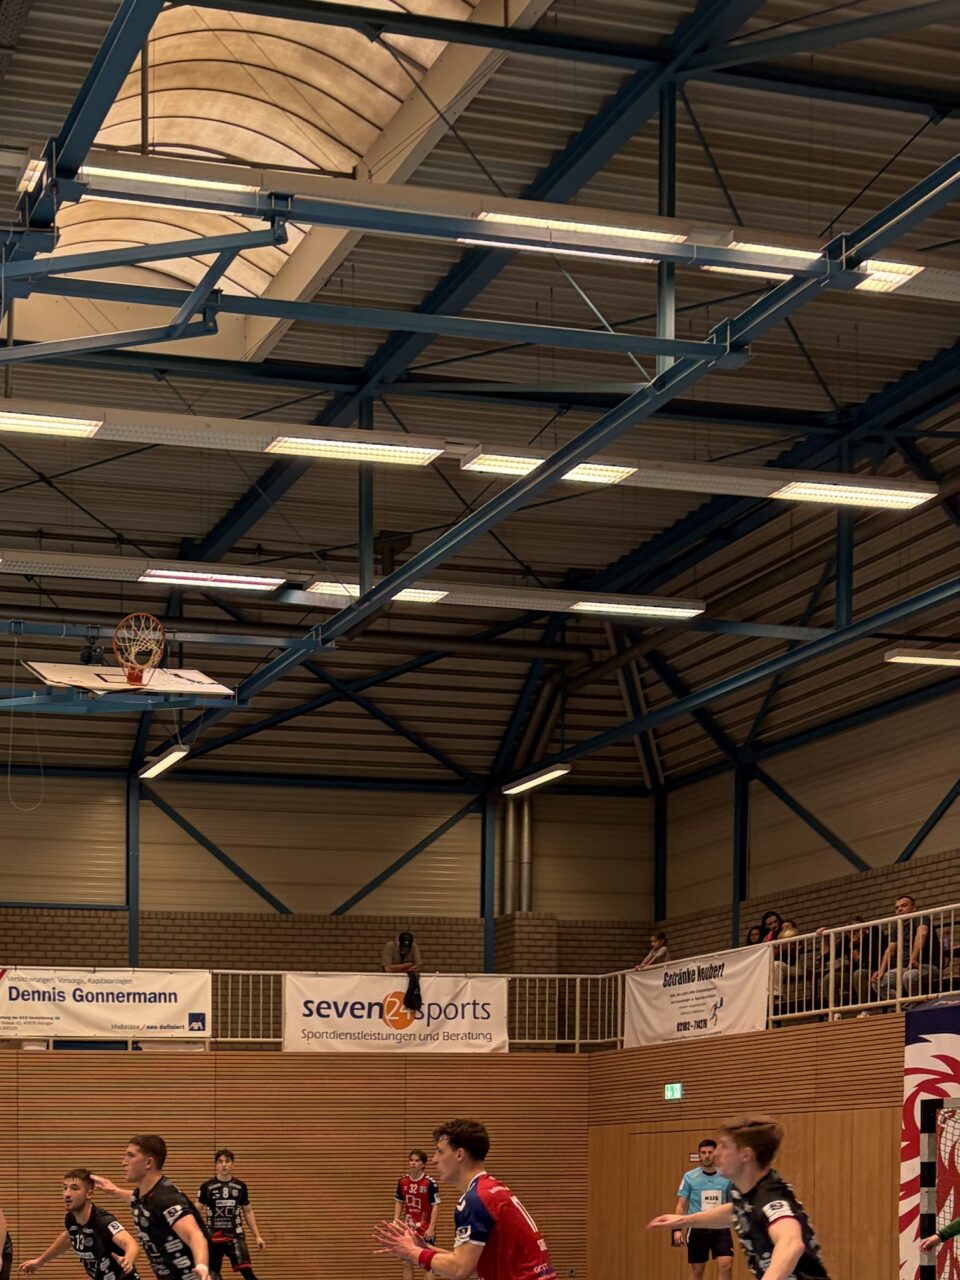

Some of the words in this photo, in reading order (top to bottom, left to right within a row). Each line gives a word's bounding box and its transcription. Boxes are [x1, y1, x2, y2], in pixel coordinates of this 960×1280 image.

[8, 986, 66, 1002] Dennis
[72, 987, 178, 1004] Gonnermann
[301, 1028, 416, 1043] Sportdienstleistungen
[419, 1032, 439, 1041] und
[442, 1031, 493, 1043] Beratung
[222, 1187, 229, 1199] 8
